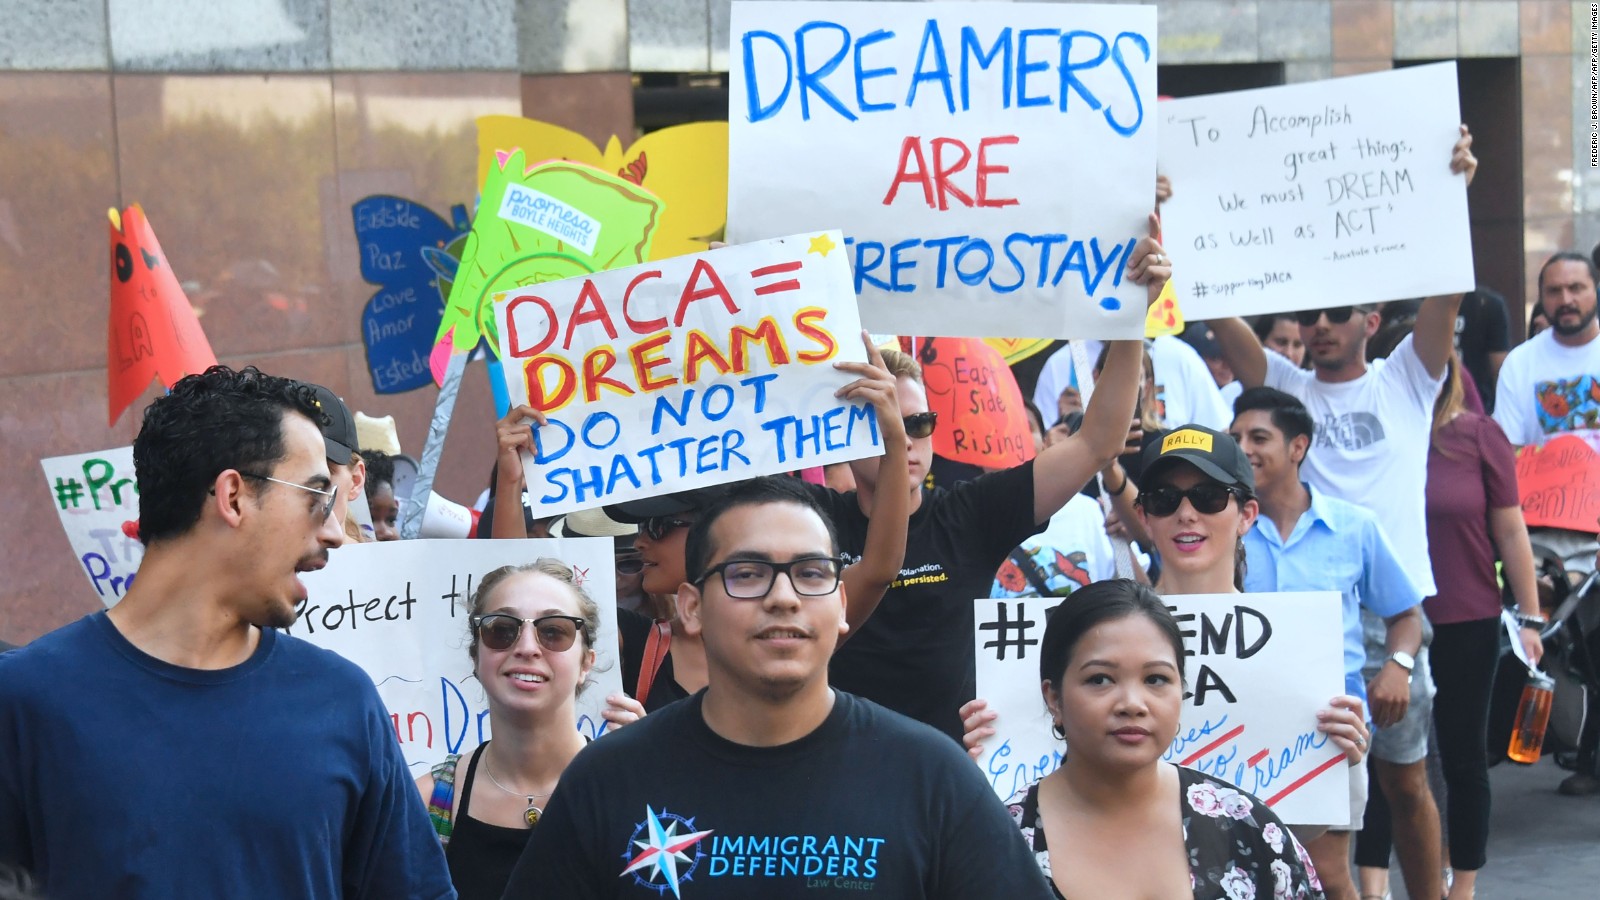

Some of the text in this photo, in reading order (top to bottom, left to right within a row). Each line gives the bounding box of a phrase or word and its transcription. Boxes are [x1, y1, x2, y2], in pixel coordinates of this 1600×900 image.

[742, 19, 1150, 138] DREAMERS
[1248, 104, 1353, 138] Accomplish
[882, 135, 1020, 211] ARE
[1283, 142, 1338, 181] great
[1218, 167, 1414, 213] We must DREAM
[357, 202, 421, 232] Eastside
[507, 188, 592, 235] promesa
[511, 205, 589, 247] BOYLE HEIGHTS
[1194, 231, 1219, 251] as
[1293, 222, 1316, 240] as
[367, 243, 406, 271] Paz
[372, 287, 417, 314] Love
[506, 258, 742, 359] DACA
[368, 313, 416, 346] Amor
[523, 306, 839, 414] DREAMS
[954, 357, 997, 386] East
[969, 390, 1007, 415] Side
[530, 373, 779, 466] DO NOT
[540, 403, 879, 504] SHATTER THEM
[953, 429, 1024, 462] Rising
[1167, 434, 1205, 448] RALLY
[904, 573, 949, 587] persisted.
[710, 835, 885, 858] IMMIGRANT
[708, 856, 879, 879] DEFENDERS
[806, 876, 876, 891] Law Center
